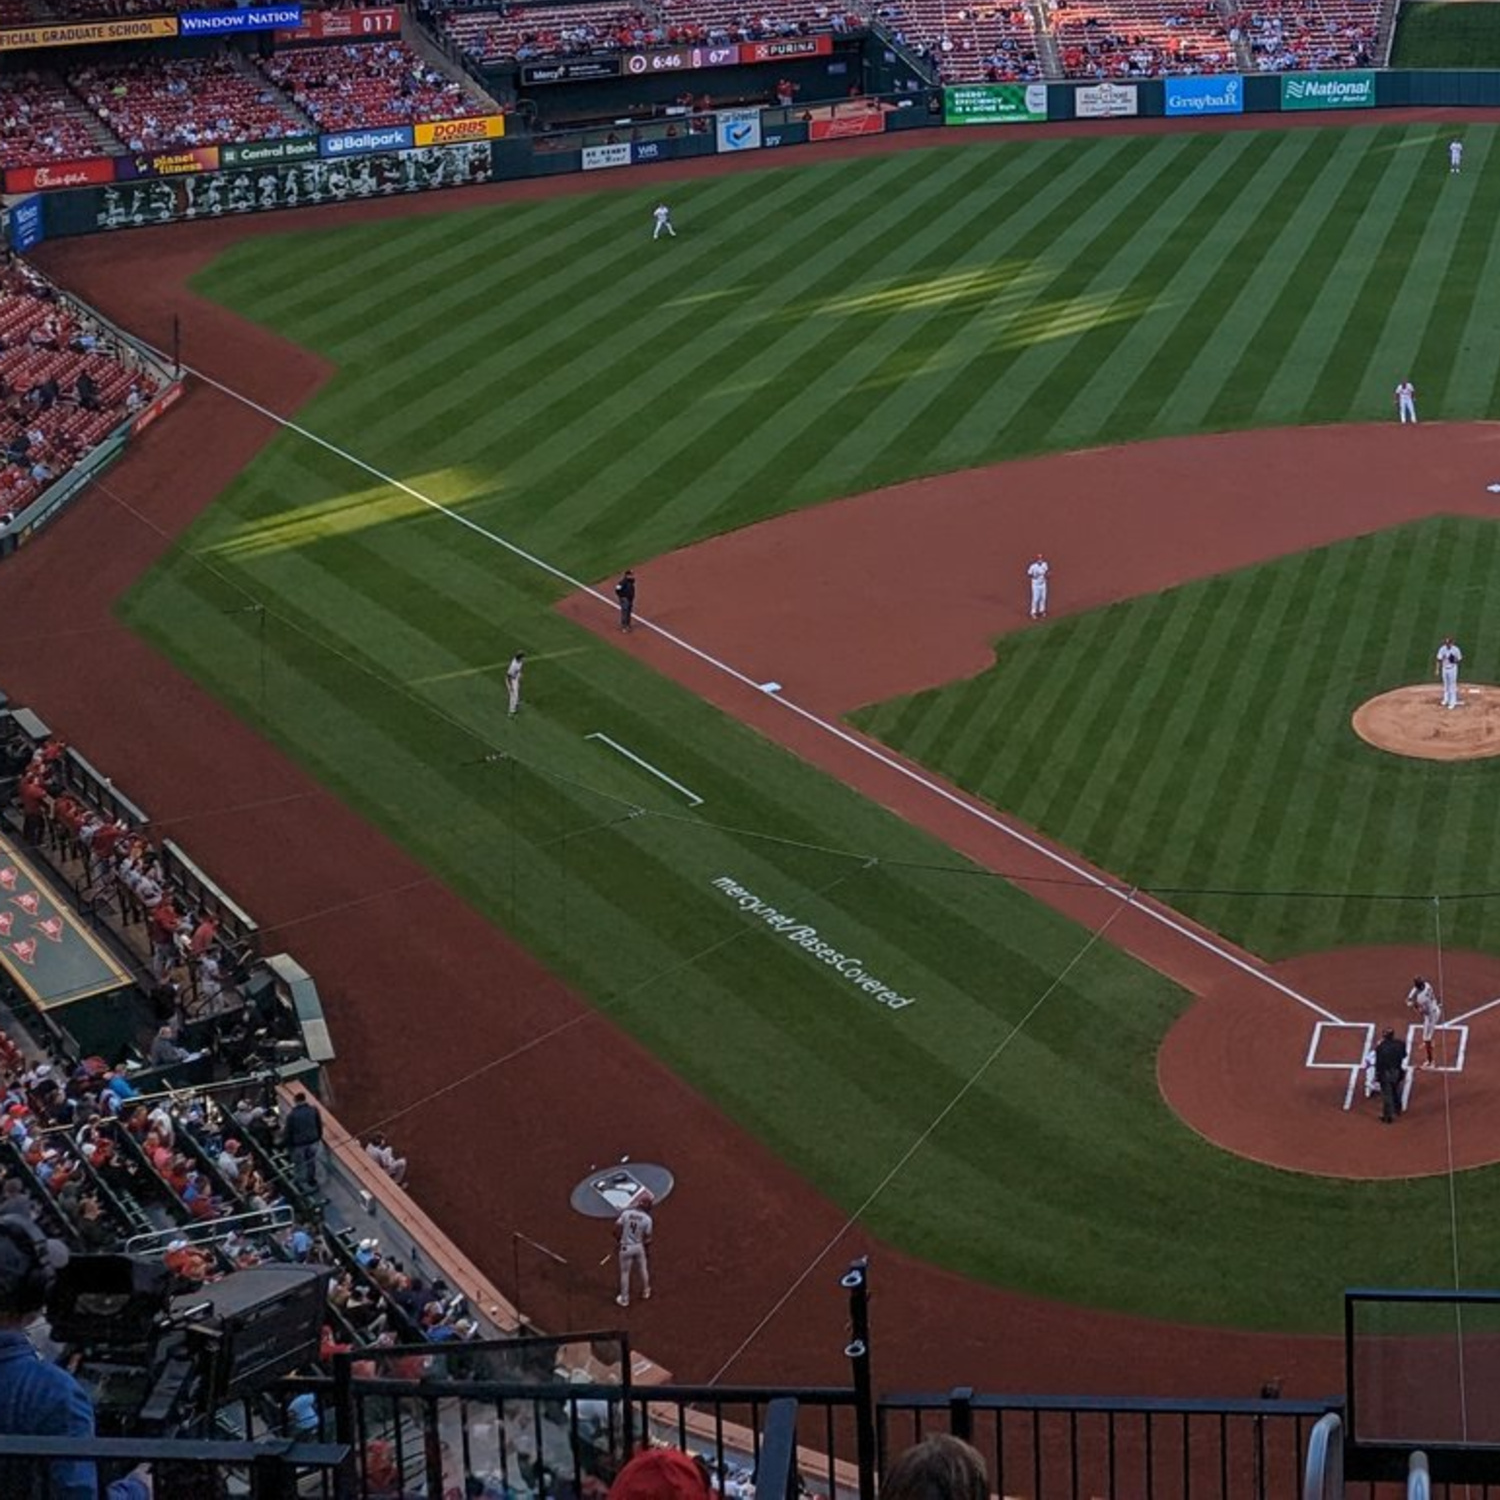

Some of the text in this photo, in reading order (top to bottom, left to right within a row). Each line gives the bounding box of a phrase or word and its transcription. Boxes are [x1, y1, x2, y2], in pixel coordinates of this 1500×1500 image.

[181, 13, 245, 31] WINDOW
[247, 10, 300, 26] NATION
[42, 28, 104, 44] GRADUATE
[109, 23, 155, 38] SCHOOL
[709, 49, 731, 63] 67°
[769, 43, 815, 56] PURINA
[652, 53, 681, 69] 6:46
[1305, 79, 1370, 96] National
[433, 120, 488, 137] DOBBS
[343, 131, 405, 151] Ballpark
[241, 141, 318, 161] Central Bank
[154, 153, 194, 168] planet
[159, 161, 204, 175] fitness
[711, 876, 916, 1010] mercy.net/BasesCovered
